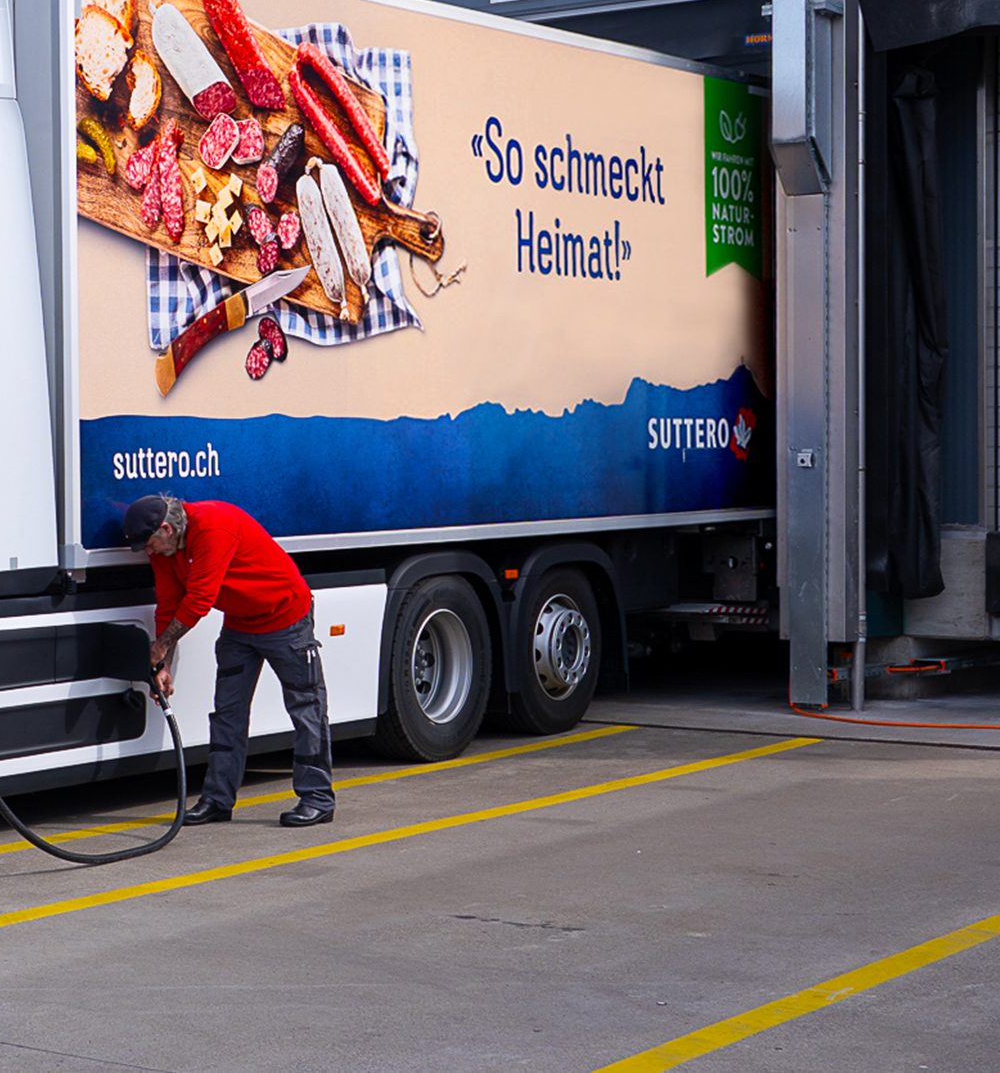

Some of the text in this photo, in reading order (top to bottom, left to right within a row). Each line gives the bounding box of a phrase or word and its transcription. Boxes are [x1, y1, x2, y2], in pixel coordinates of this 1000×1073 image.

[471, 116, 665, 205] «So schmeckt
[711, 166, 754, 202] 100%
[711, 203, 755, 224] NATUR-
[515, 208, 631, 281] Heimat!»
[712, 224, 755, 247] STROM
[648, 417, 729, 449] SUTTERO
[113, 442, 220, 480] suttero.ch
